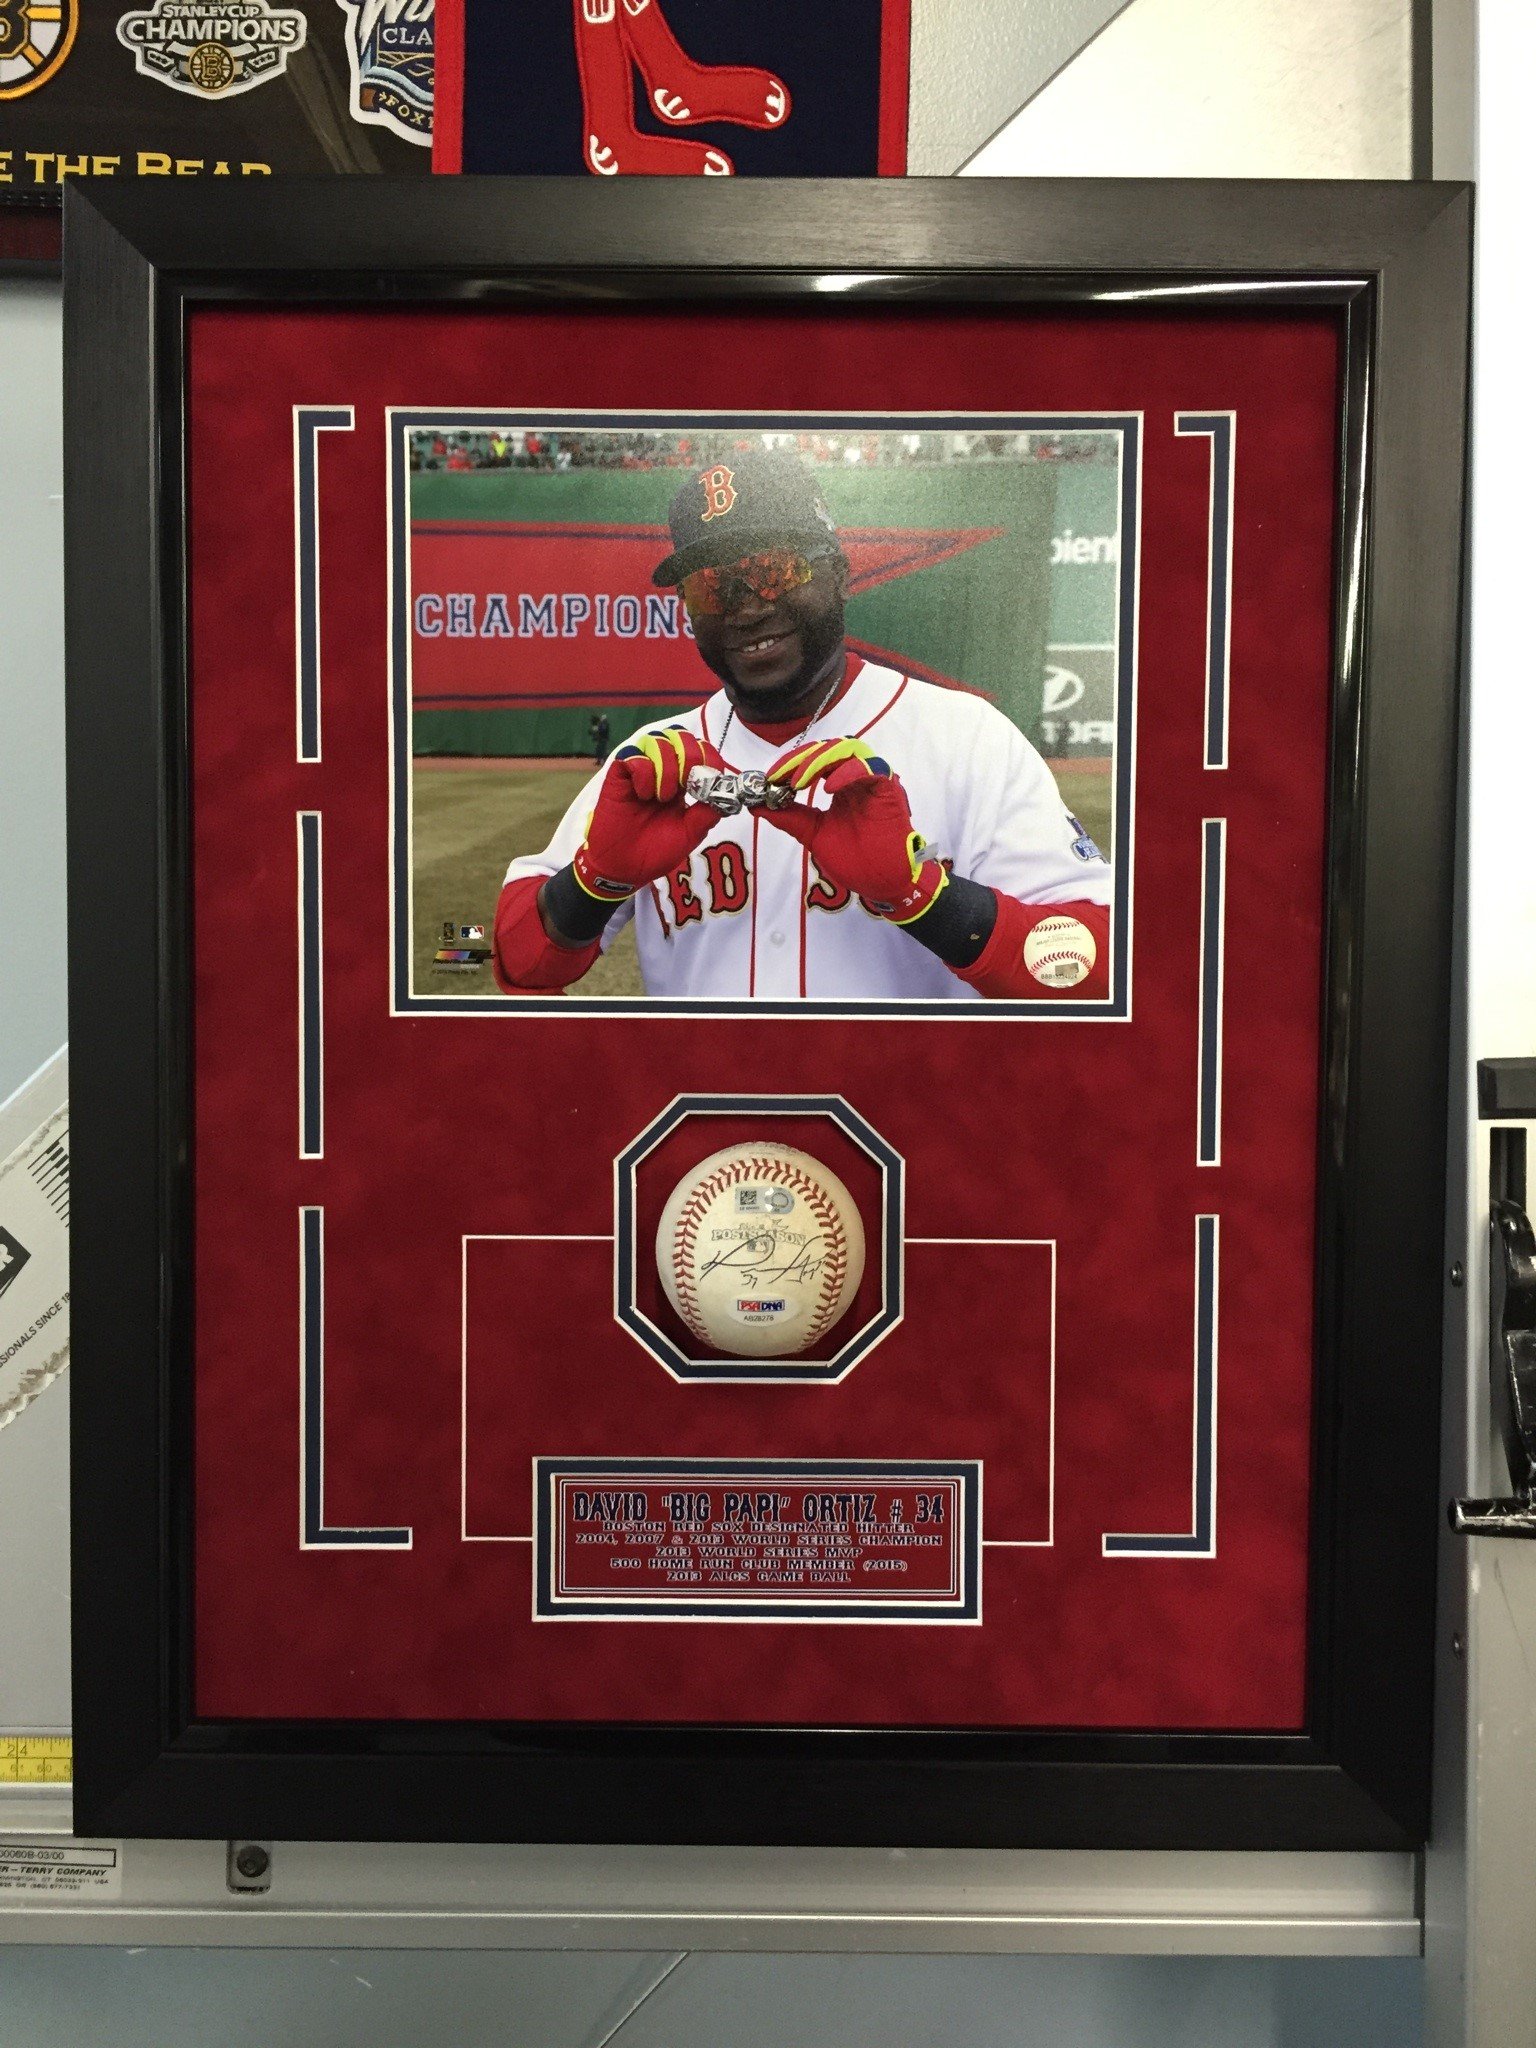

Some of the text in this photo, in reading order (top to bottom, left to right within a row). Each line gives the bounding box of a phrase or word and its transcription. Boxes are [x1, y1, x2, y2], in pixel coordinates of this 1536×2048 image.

[163, 5, 259, 18] STANLEY CUP
[126, 19, 296, 42] CHAMPIONS
[25, 151, 121, 184] THE
[902, 889, 922, 907] 34
[711, 1229, 807, 1246] POSTSEASON
[35, 1301, 63, 1329] SINCE
[573, 1492, 945, 1525] DAVID "BIG PAPI" ORTIZ # 34
[603, 1521, 915, 1534] BOSTON RED SOX DESIGNATED HITTER
[575, 1533, 943, 1547] 2004, 2007 & 2013 WORLD SERIES CHAMPION
[655, 1546, 863, 1558] 2013 WORLD SERIES MVP
[610, 1558, 908, 1572] 500 HOME RUN CLUB MEMBER (2015)
[667, 1571, 852, 1582] 2013 ALCS GAME BALL
[7, 1744, 28, 1757] 24
[57, 1868, 107, 1876] COMPANY
